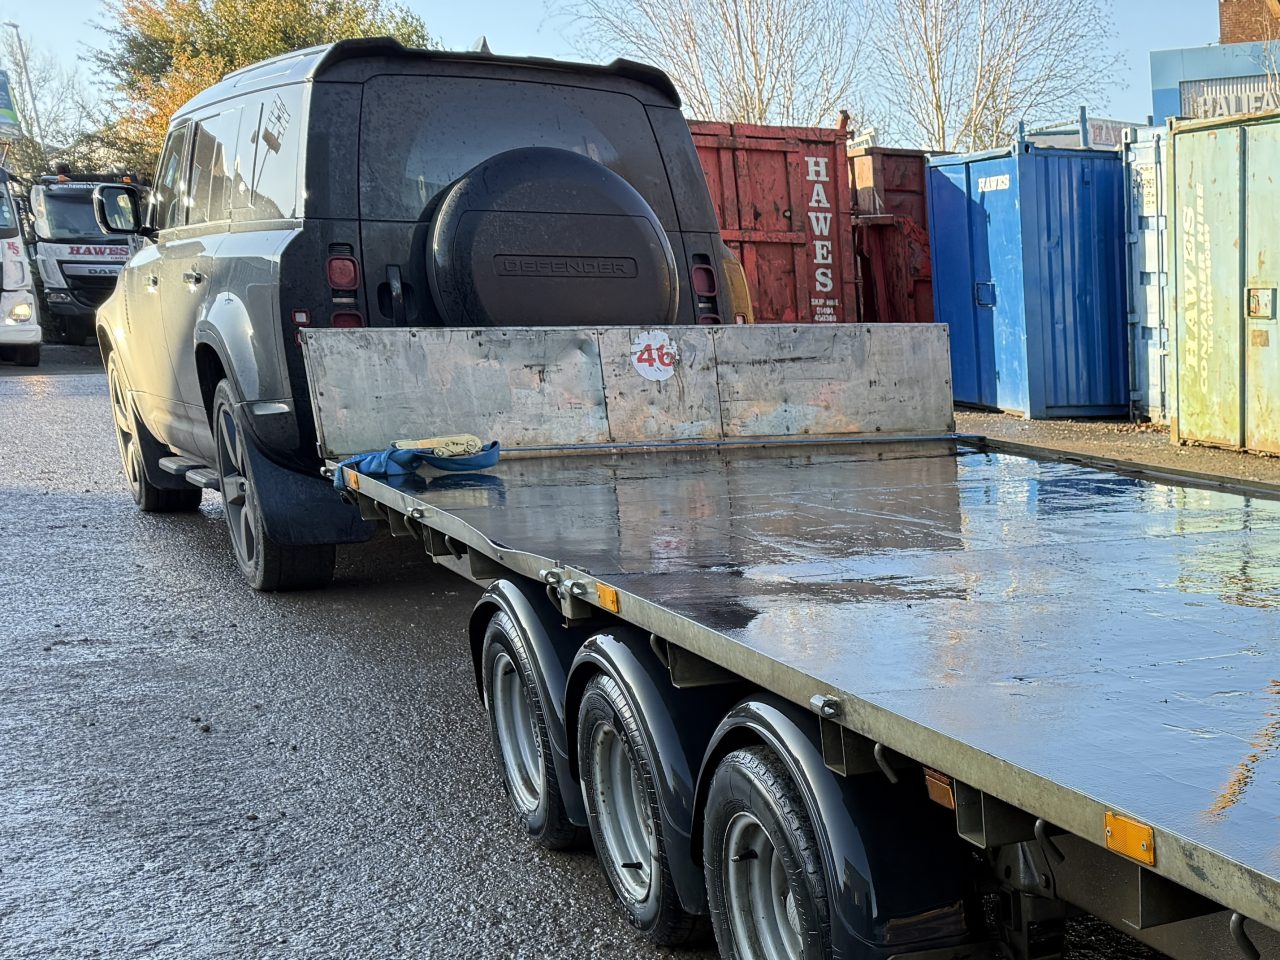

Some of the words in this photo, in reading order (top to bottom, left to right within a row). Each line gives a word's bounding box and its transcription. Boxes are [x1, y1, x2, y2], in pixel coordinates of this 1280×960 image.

[977, 174, 1010, 192] HAWES
[805, 157, 833, 292] HAWES
[1196, 182, 1206, 243] HIRE
[68, 245, 130, 256] HAWES
[503, 260, 627, 274] DEFENDER
[1183, 206, 1199, 372] HAWES
[1198, 252, 1210, 394] CONTAINER
[636, 343, 675, 368] 46
